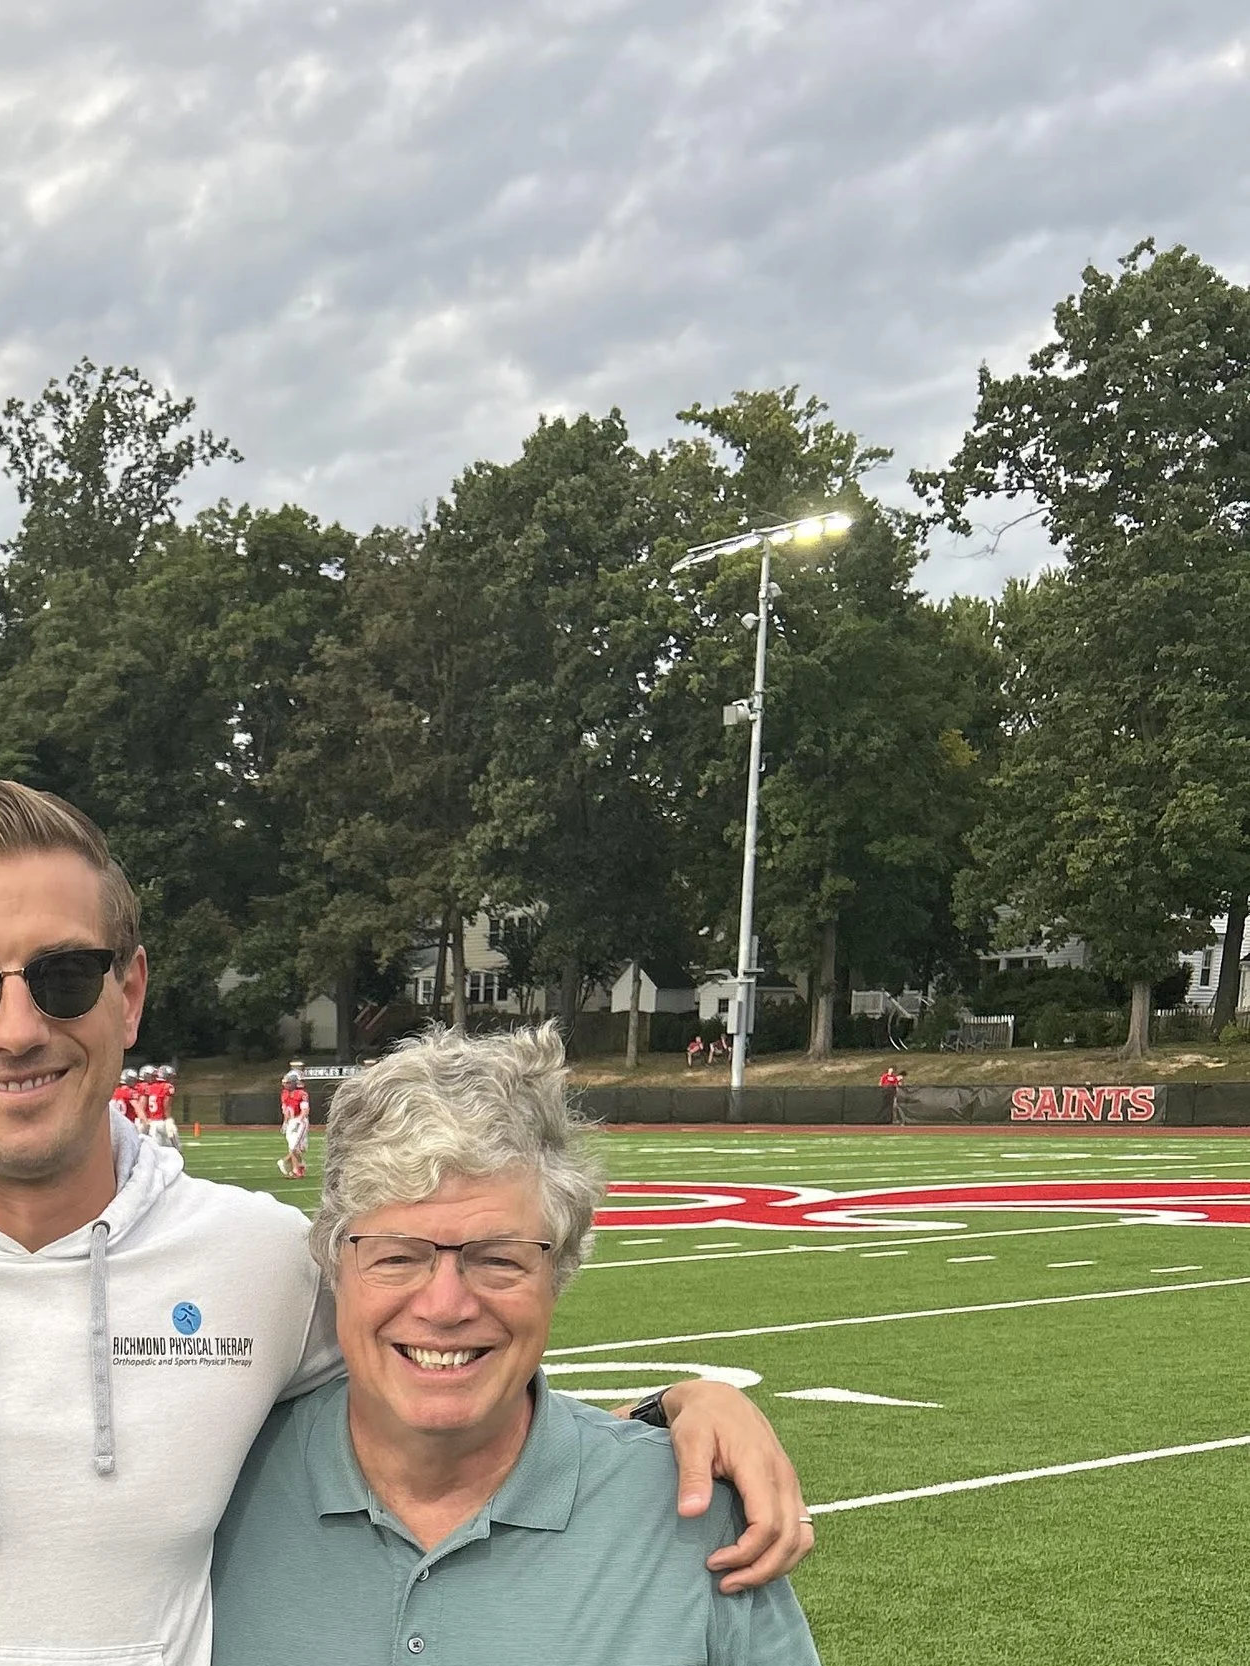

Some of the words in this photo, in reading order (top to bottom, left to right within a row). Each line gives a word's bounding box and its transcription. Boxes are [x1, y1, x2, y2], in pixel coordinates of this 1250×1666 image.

[1011, 1086, 1155, 1122] SAINTS
[113, 1337, 166, 1356] RICHMOND
[170, 1337, 213, 1356] PHYSICAL
[215, 1337, 253, 1356] THERAPY
[112, 1357, 156, 1366] Orthopedic
[174, 1357, 198, 1366] Sports
[199, 1357, 226, 1367] Physical
[227, 1357, 253, 1368] Therapy
